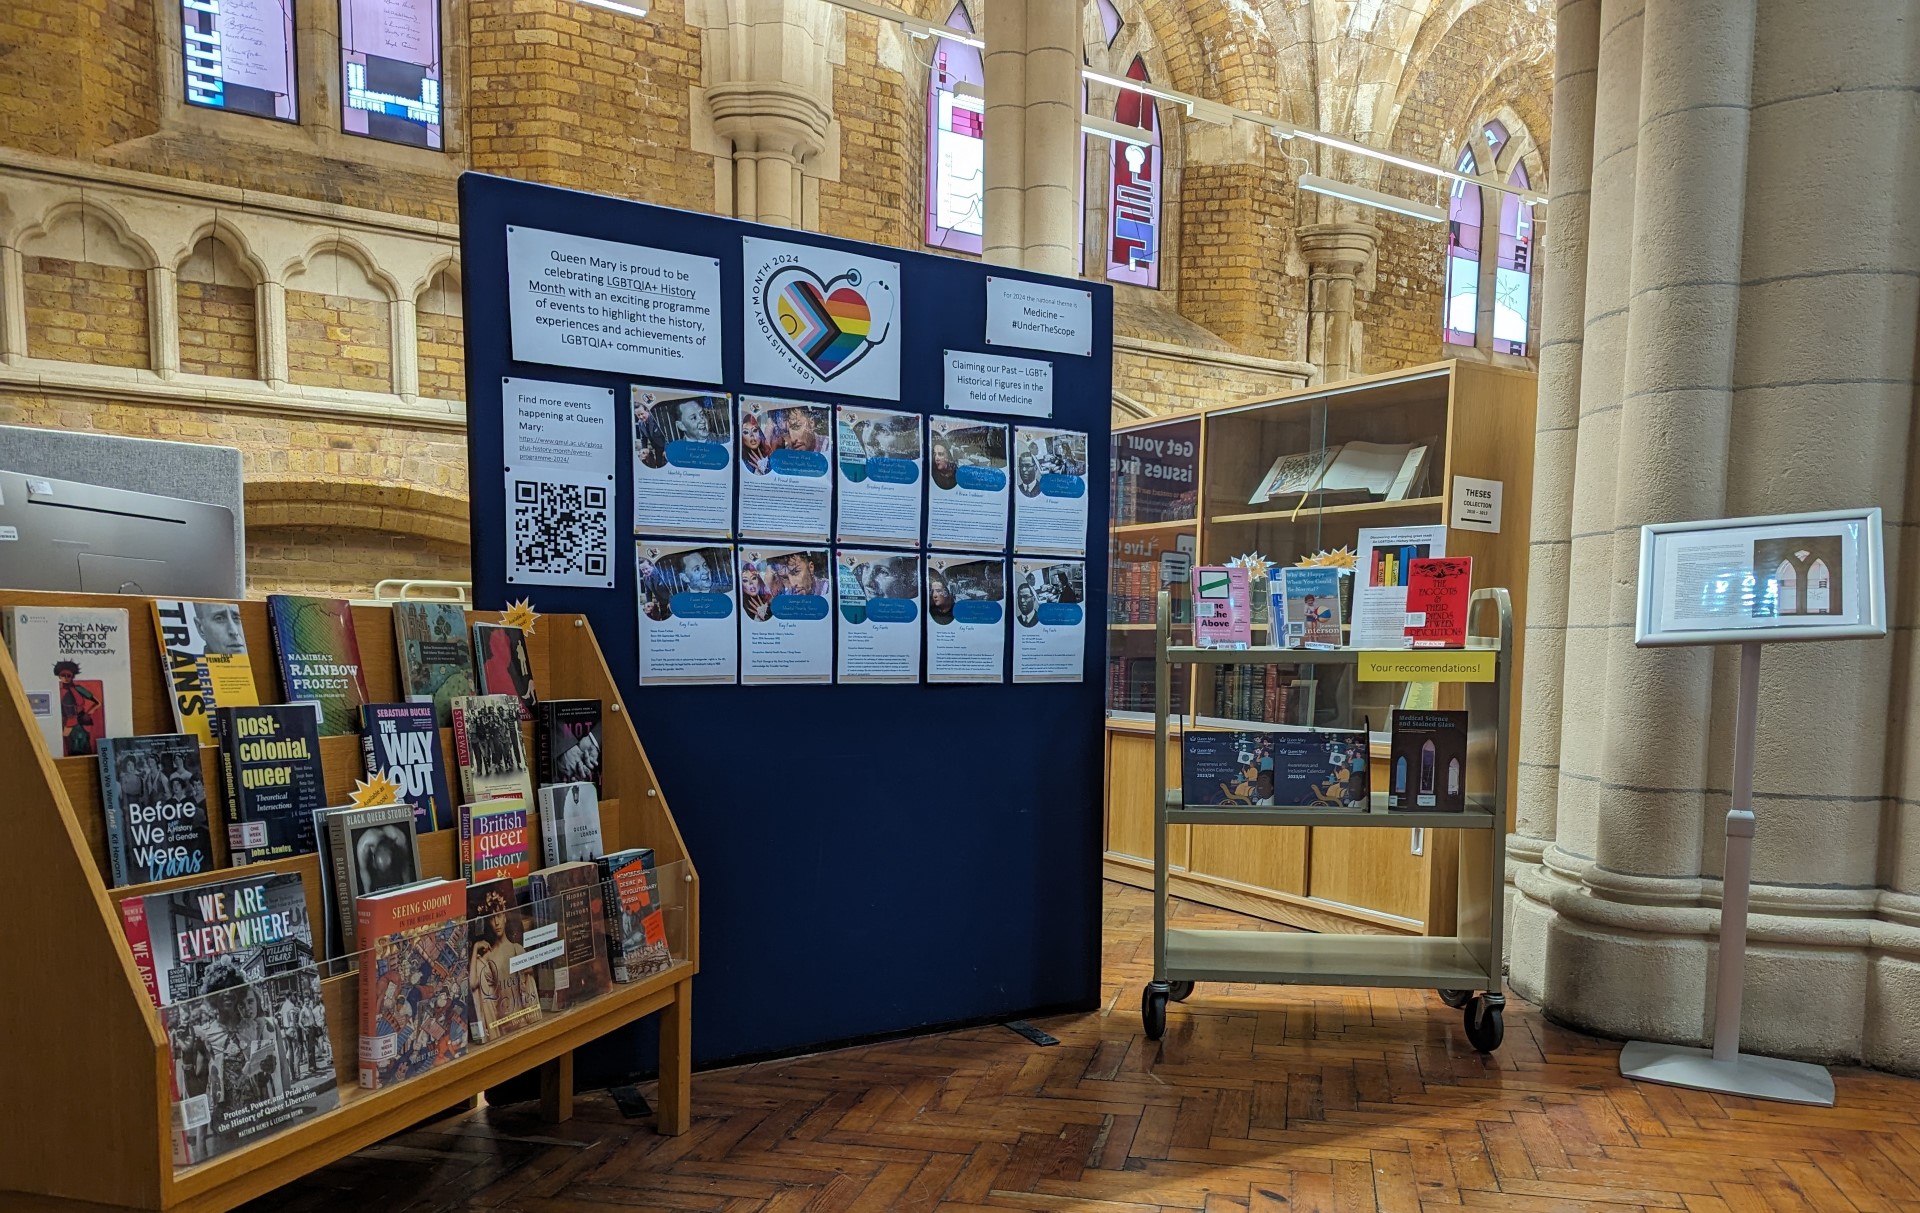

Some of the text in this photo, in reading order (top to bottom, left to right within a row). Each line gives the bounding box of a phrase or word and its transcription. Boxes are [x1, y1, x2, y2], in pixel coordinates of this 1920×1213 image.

[550, 250, 689, 282] Queen Mary is proud to be
[544, 266, 696, 300] celebrating LGBTQIA+ History
[529, 280, 710, 316] Month with an exciting programme
[536, 298, 706, 332] of events to highlight the history,
[752, 254, 816, 384] LGBT+ HISTORY MONTH 2024
[1024, 307, 1058, 320] Medicine
[536, 315, 706, 346] experiences and achievements of
[1012, 320, 1076, 337] #UnderTheScope
[561, 334, 684, 358] LGBTQIA+ communities.
[952, 360, 1048, 378] Claiming our Past LGBT+
[958, 376, 1044, 392] Historical Figures in the
[518, 394, 592, 410] Find more events
[970, 391, 1032, 404] field of Medicine
[518, 408, 604, 424] happening at Queen
[519, 422, 544, 432] Mary:
[1466, 488, 1492, 498] THESES
[1464, 500, 1492, 508] COLLECTION
[58, 622, 118, 633] Zami: A New
[1201, 620, 1230, 628] Above
[58, 631, 108, 642] Spelling of
[58, 640, 106, 650] My Name
[158, 602, 206, 717] TRANS
[288, 653, 333, 662] NAMIBIA'S
[290, 664, 358, 677] RAINBOW
[1370, 664, 1481, 672] Your reccomendations!
[294, 678, 348, 690] PROJECT
[194, 653, 219, 739] LIBERATION
[377, 708, 431, 718] SEBASTIAN BUCKLE
[236, 714, 280, 738] post-
[379, 720, 397, 733] THE
[563, 722, 592, 738] NOT
[454, 710, 469, 766] STONEWALL
[240, 738, 312, 762] colonial,
[380, 731, 434, 766] WAY
[100, 746, 110, 774] Before
[105, 774, 112, 788] We
[242, 766, 292, 790] queer
[388, 763, 434, 798] OUT
[106, 788, 114, 809] Were
[256, 792, 288, 802] Theoretical
[128, 800, 196, 824] Before
[257, 802, 292, 812] Intersections
[346, 807, 412, 826] BLACK QUEER STUDIES
[480, 811, 522, 835] British
[131, 824, 164, 846] We
[176, 832, 199, 842] Gender
[480, 830, 522, 857] queer
[580, 830, 598, 838] LONDON
[134, 846, 188, 868] Were
[482, 850, 522, 871] history
[198, 886, 268, 923] WE ARE
[392, 894, 452, 920] SEEING SODOMY
[177, 910, 294, 962] EVERYWHERE
[266, 944, 293, 956] VILLAGE
[268, 952, 292, 963] CIGARS
[218, 1091, 317, 1132] the History of Queer Liberation
[224, 1084, 310, 1120] Protest, Power, and Pride in
